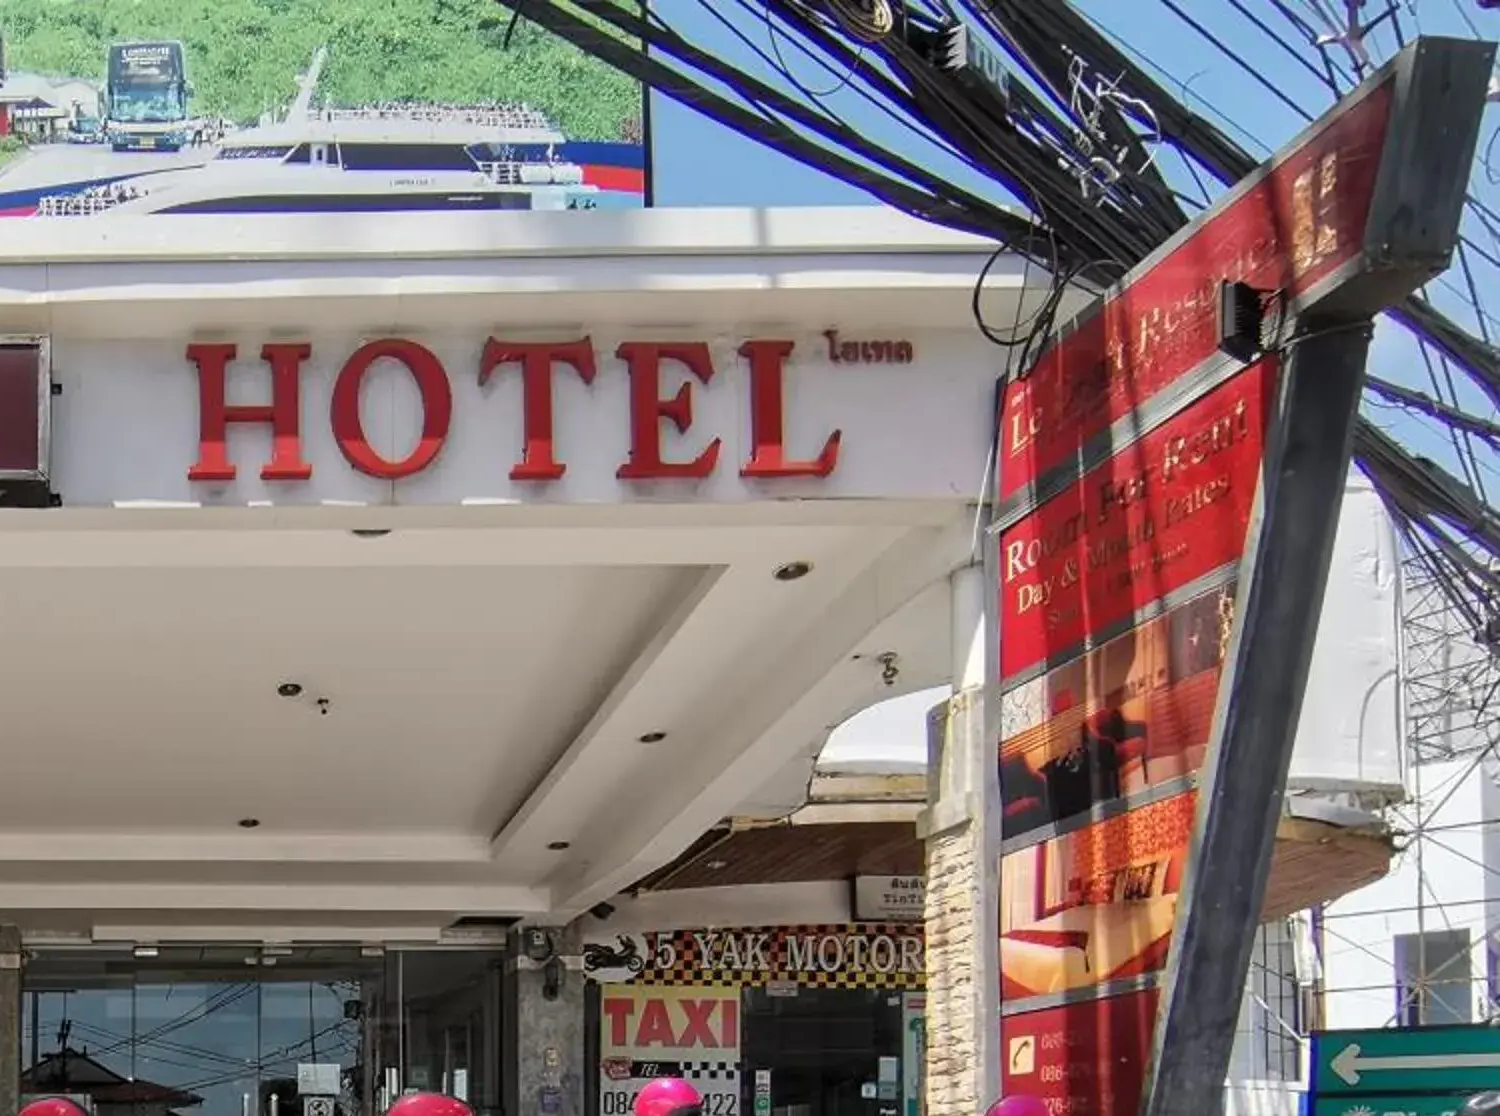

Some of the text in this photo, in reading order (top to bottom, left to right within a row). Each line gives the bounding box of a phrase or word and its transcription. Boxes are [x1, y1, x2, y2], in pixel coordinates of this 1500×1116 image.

[186, 336, 842, 481] HOTEL
[1161, 397, 1249, 485] Rent
[1017, 573, 1056, 615] Day
[656, 932, 676, 969] 5
[692, 933, 770, 971] YAK
[604, 998, 738, 1048] TAXI
